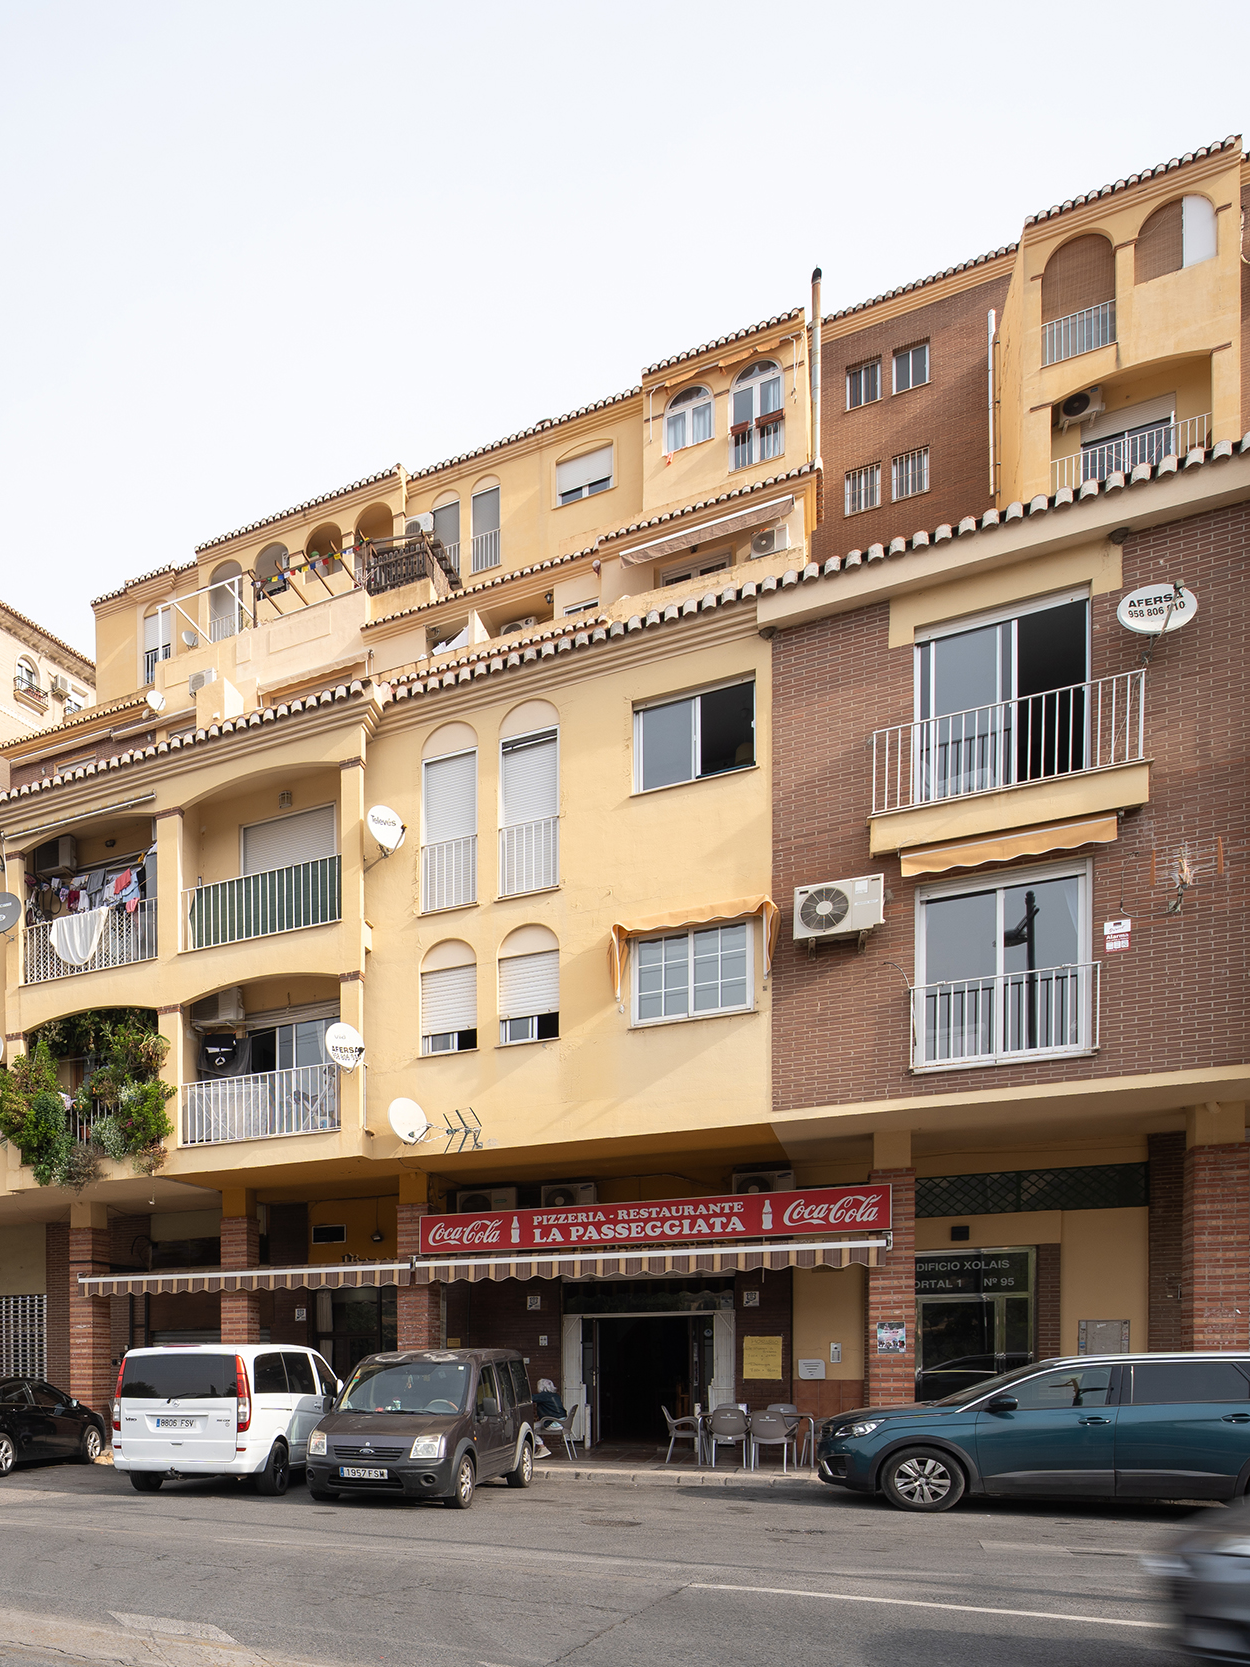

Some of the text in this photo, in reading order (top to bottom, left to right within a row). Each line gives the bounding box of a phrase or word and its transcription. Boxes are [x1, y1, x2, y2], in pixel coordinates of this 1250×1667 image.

[1128, 610, 1145, 618] 958
[1147, 607, 1165, 616] 806
[533, 1211, 606, 1226] PIZZERIA
[617, 1201, 744, 1220] RESTAURANTE
[783, 1194, 883, 1227] Coca-Cola
[428, 1219, 503, 1246] Coca-Cola
[533, 1216, 746, 1243] LA PASSEGGIATA
[915, 1259, 1010, 1272] DIFICIO XOLAIS
[915, 1279, 953, 1289] ORTAL
[956, 1279, 962, 1287] 1
[1000, 1277, 1015, 1287] 95
[160, 1419, 194, 1427] 8806 FSV
[346, 1468, 366, 1477] 1957
